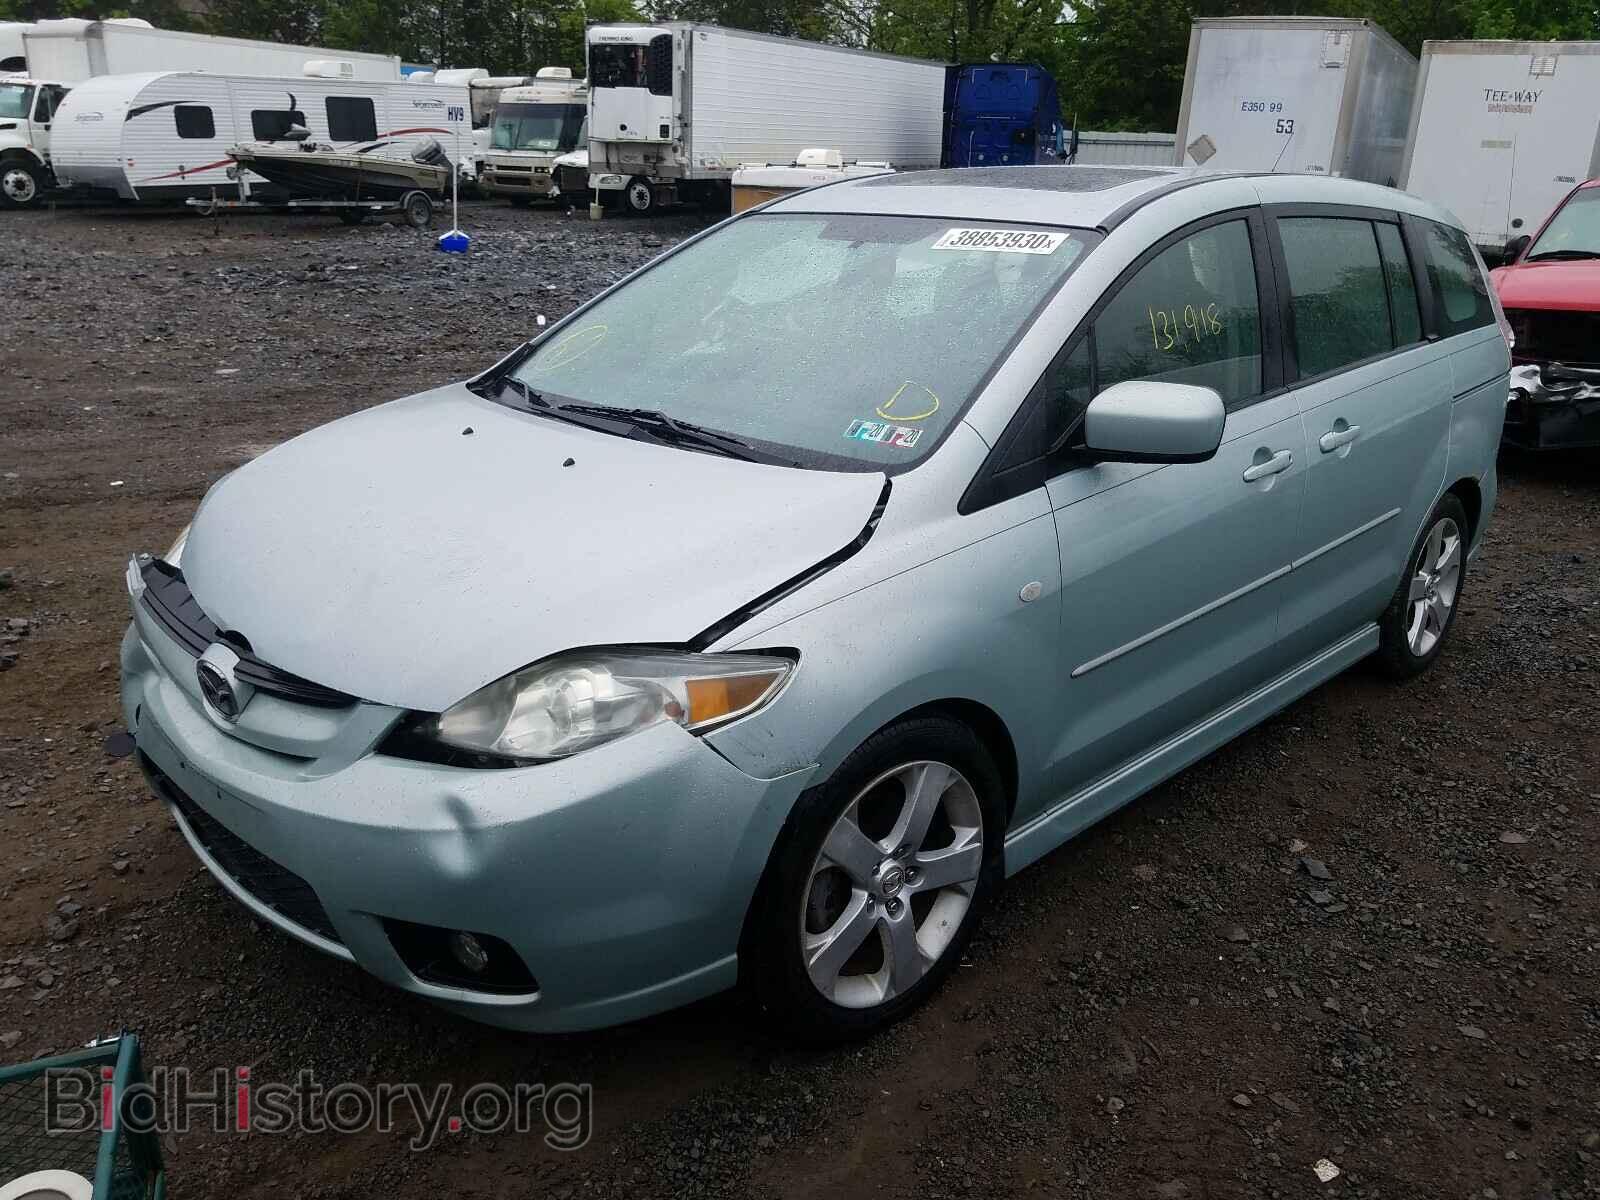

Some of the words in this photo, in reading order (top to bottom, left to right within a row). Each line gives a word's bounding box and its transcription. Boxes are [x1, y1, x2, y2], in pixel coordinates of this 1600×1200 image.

[447, 106, 464, 121] HV9
[1241, 101, 1265, 112] E350
[1269, 102, 1283, 112] 99
[1276, 119, 1294, 134] 53
